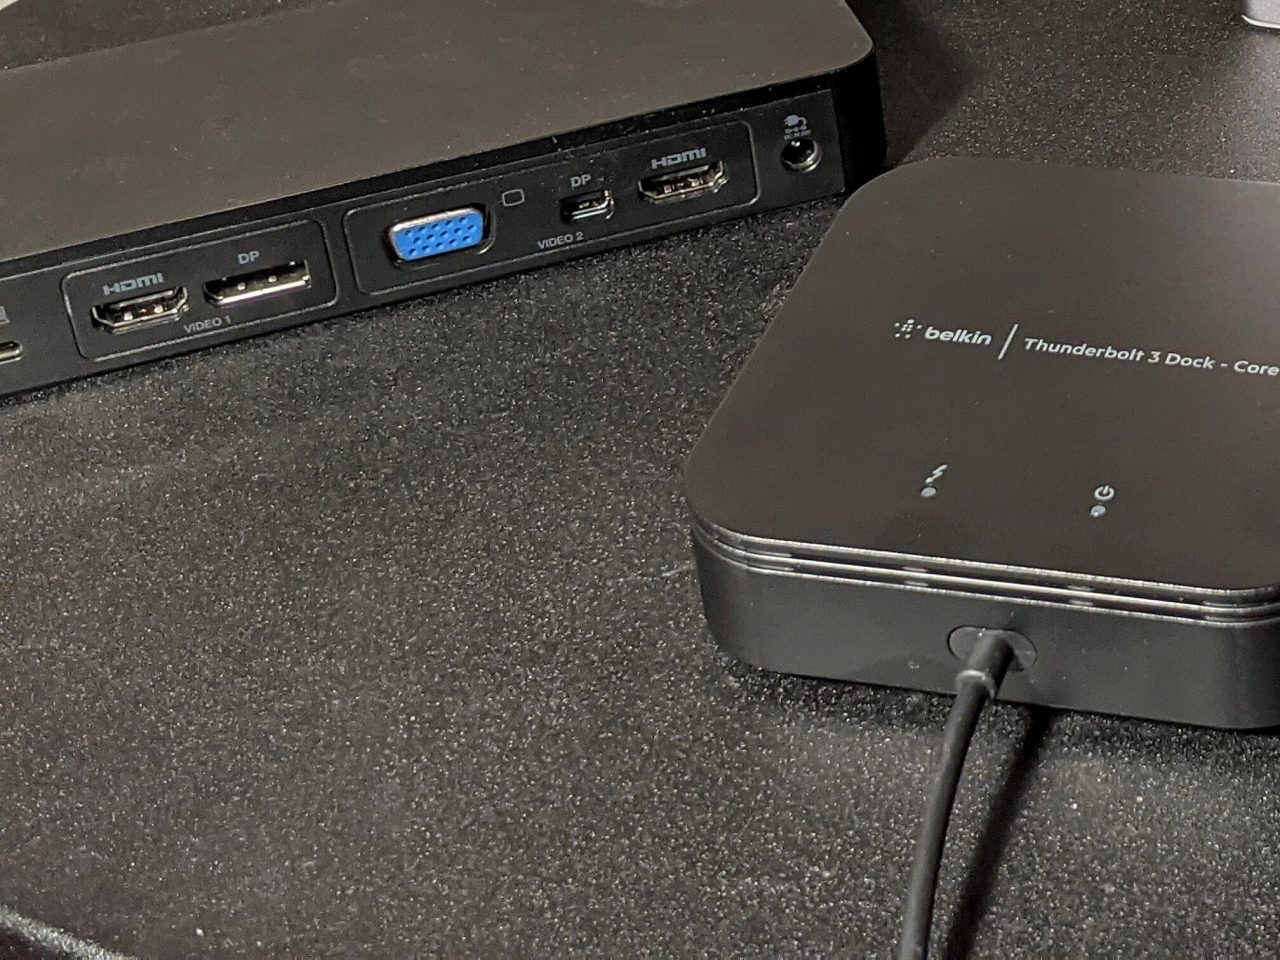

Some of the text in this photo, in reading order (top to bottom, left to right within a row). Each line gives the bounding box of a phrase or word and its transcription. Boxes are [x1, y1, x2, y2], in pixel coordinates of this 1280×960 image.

[651, 147, 708, 170] HDMI
[571, 173, 592, 189] DP
[537, 231, 584, 250] VIDEO 2
[238, 250, 260, 266] DP
[103, 273, 164, 296] HDMI
[184, 314, 232, 334] VIDEO 1
[924, 326, 992, 347] belkin
[1024, 336, 1144, 362] Thunderbolt
[1148, 350, 1161, 364] 3
[1164, 352, 1215, 371] Dock
[1233, 359, 1280, 377] Core
